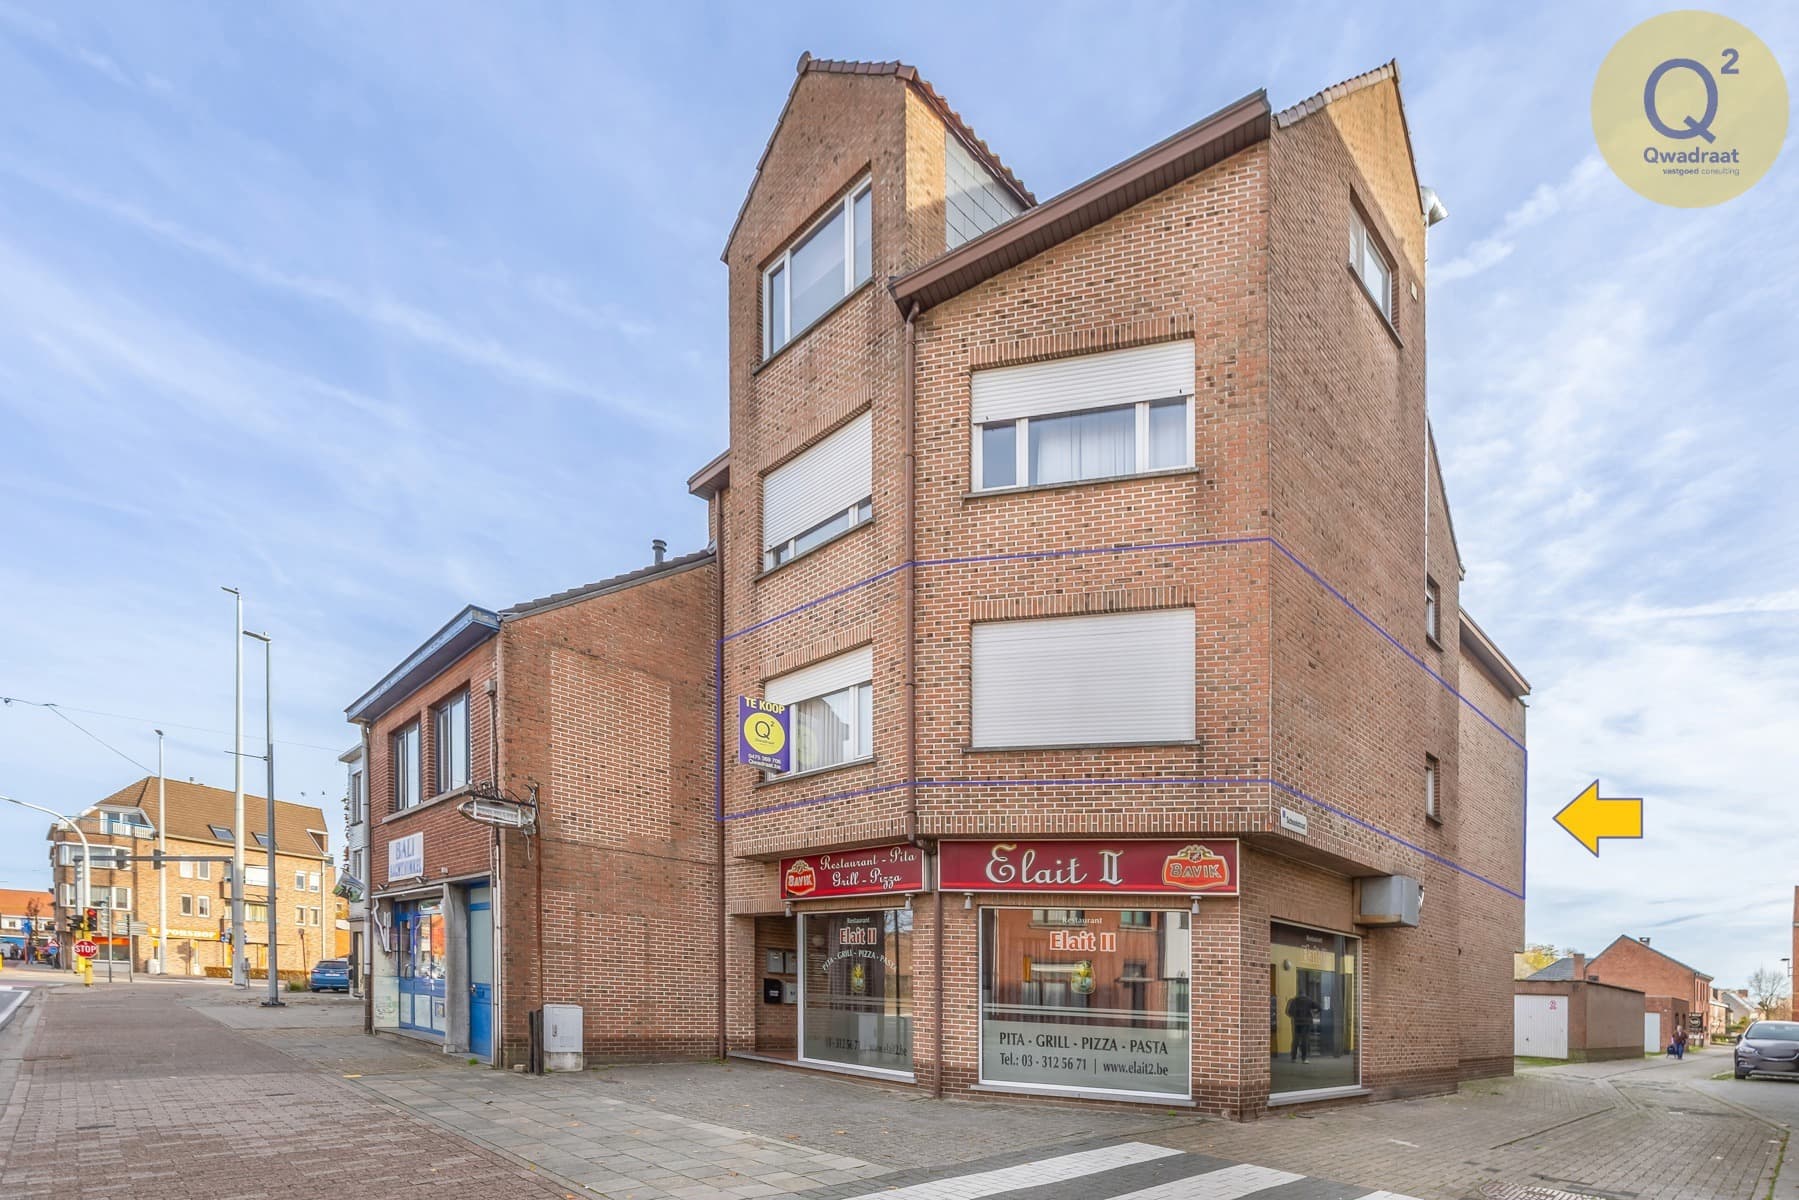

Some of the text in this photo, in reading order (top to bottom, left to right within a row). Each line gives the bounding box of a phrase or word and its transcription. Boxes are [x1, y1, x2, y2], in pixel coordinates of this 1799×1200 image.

[744, 697, 785, 715] TE KOOP
[396, 838, 415, 860] BALI
[820, 854, 878, 871] Restaurant
[890, 846, 917, 864] Pita
[985, 844, 1125, 886] Elait II
[1170, 862, 1222, 878] BAVIK
[788, 874, 813, 886] BAVIK
[832, 871, 859, 888] Grill
[870, 867, 902, 890] Pizza
[840, 926, 877, 946] Elait II
[1050, 930, 1116, 952] Elait II
[74, 945, 98, 953] STOP
[858, 950, 876, 959] PIZZA
[1000, 1032, 1024, 1046] PITA
[1036, 1034, 1070, 1048] GRILL
[1082, 1036, 1118, 1052] PIZZA
[1130, 1040, 1168, 1055] PASTA
[1000, 1052, 1018, 1066] Tel.:
[1022, 1054, 1033, 1067] 03
[1042, 1056, 1059, 1069] 312
[1062, 1057, 1074, 1070] 56
[1076, 1058, 1086, 1071] 71
[1103, 1061, 1168, 1076] www.elait2.be
